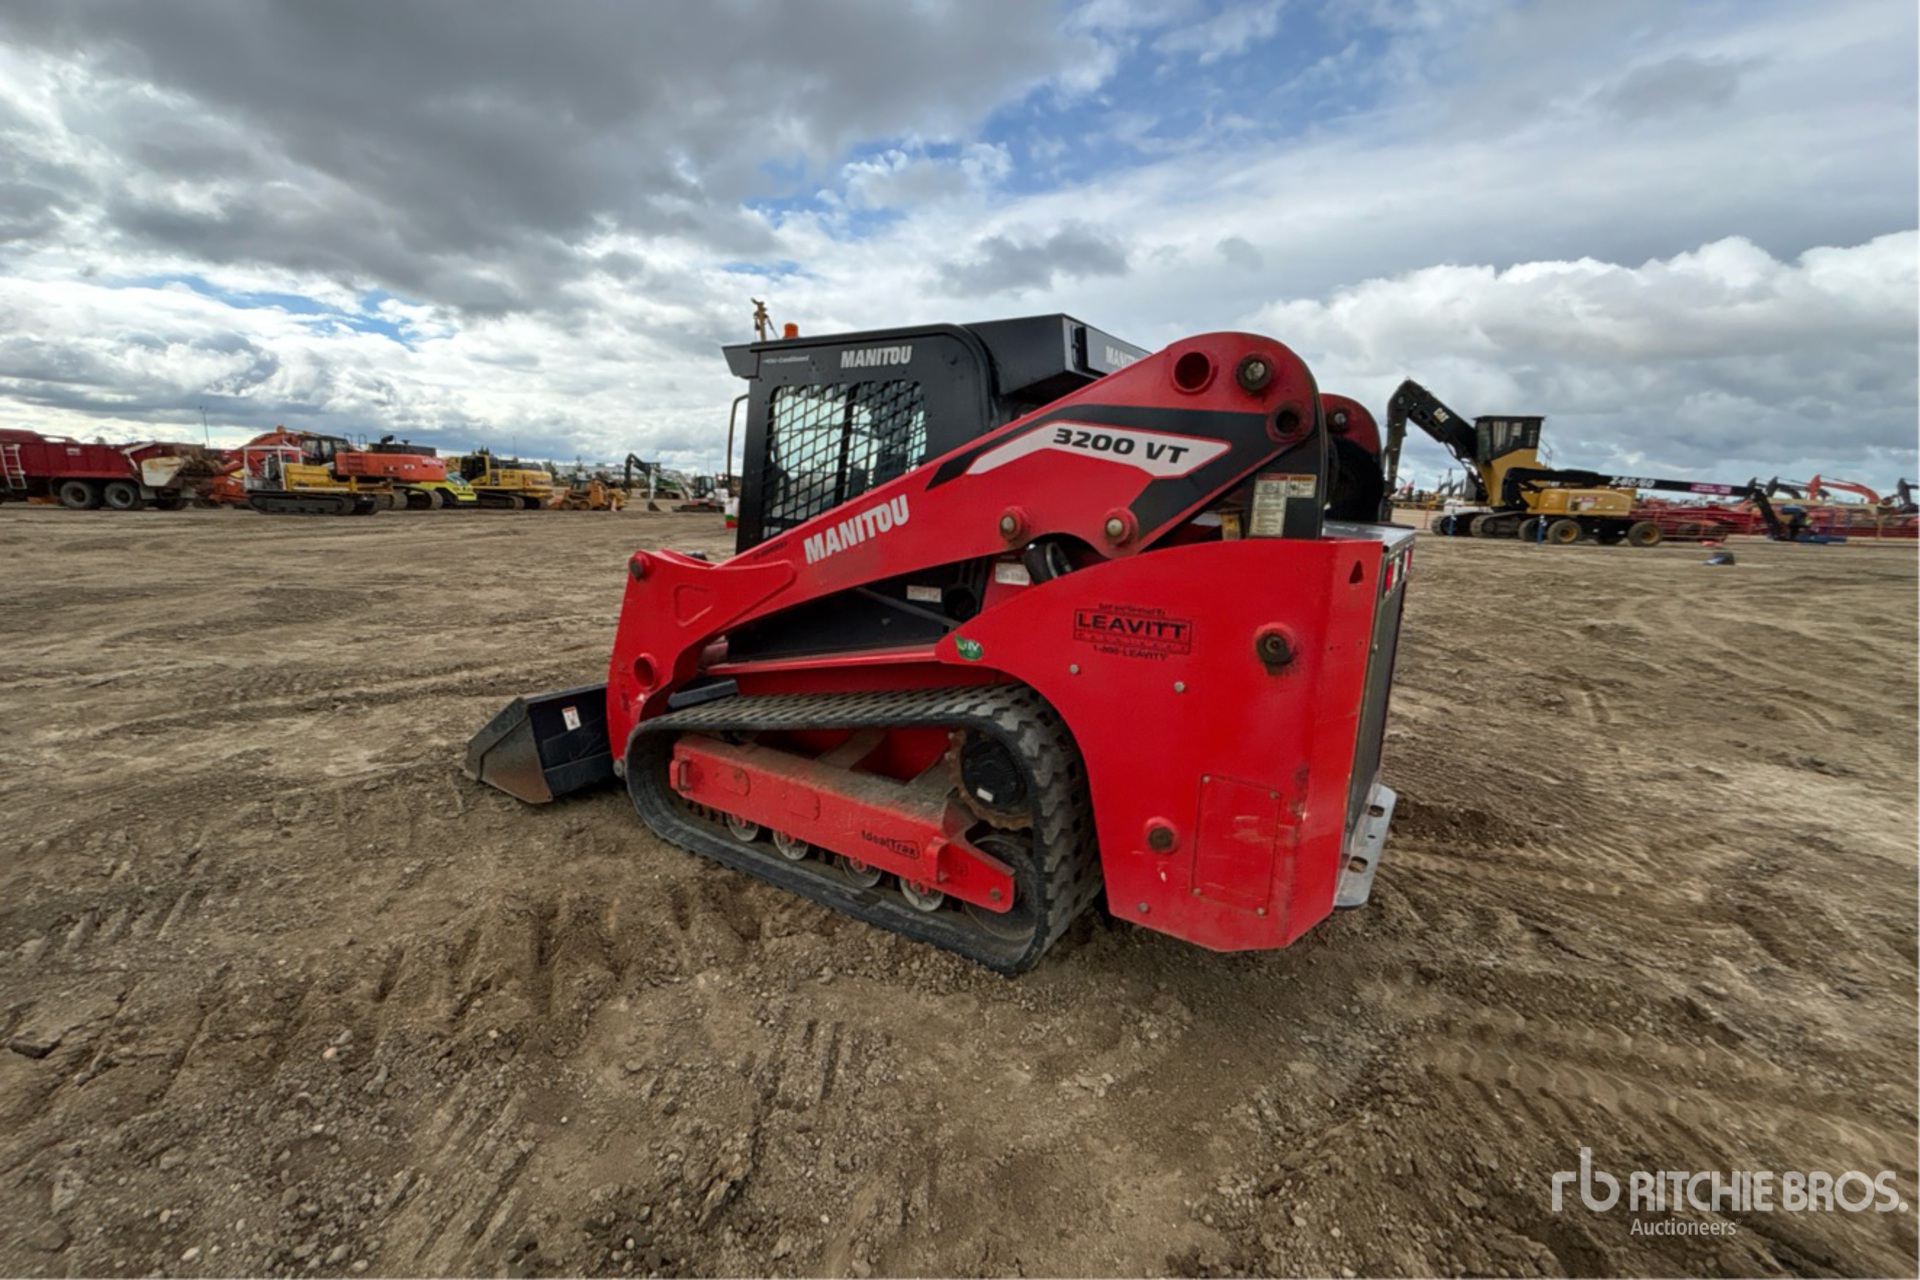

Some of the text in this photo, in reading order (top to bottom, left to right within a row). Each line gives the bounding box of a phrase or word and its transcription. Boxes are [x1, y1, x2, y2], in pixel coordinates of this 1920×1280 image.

[840, 345, 912, 368] MANITOU
[1053, 428, 1189, 463] 3200 VT
[803, 493, 910, 565] MANITOU
[1077, 613, 1186, 639] LEAVITT
